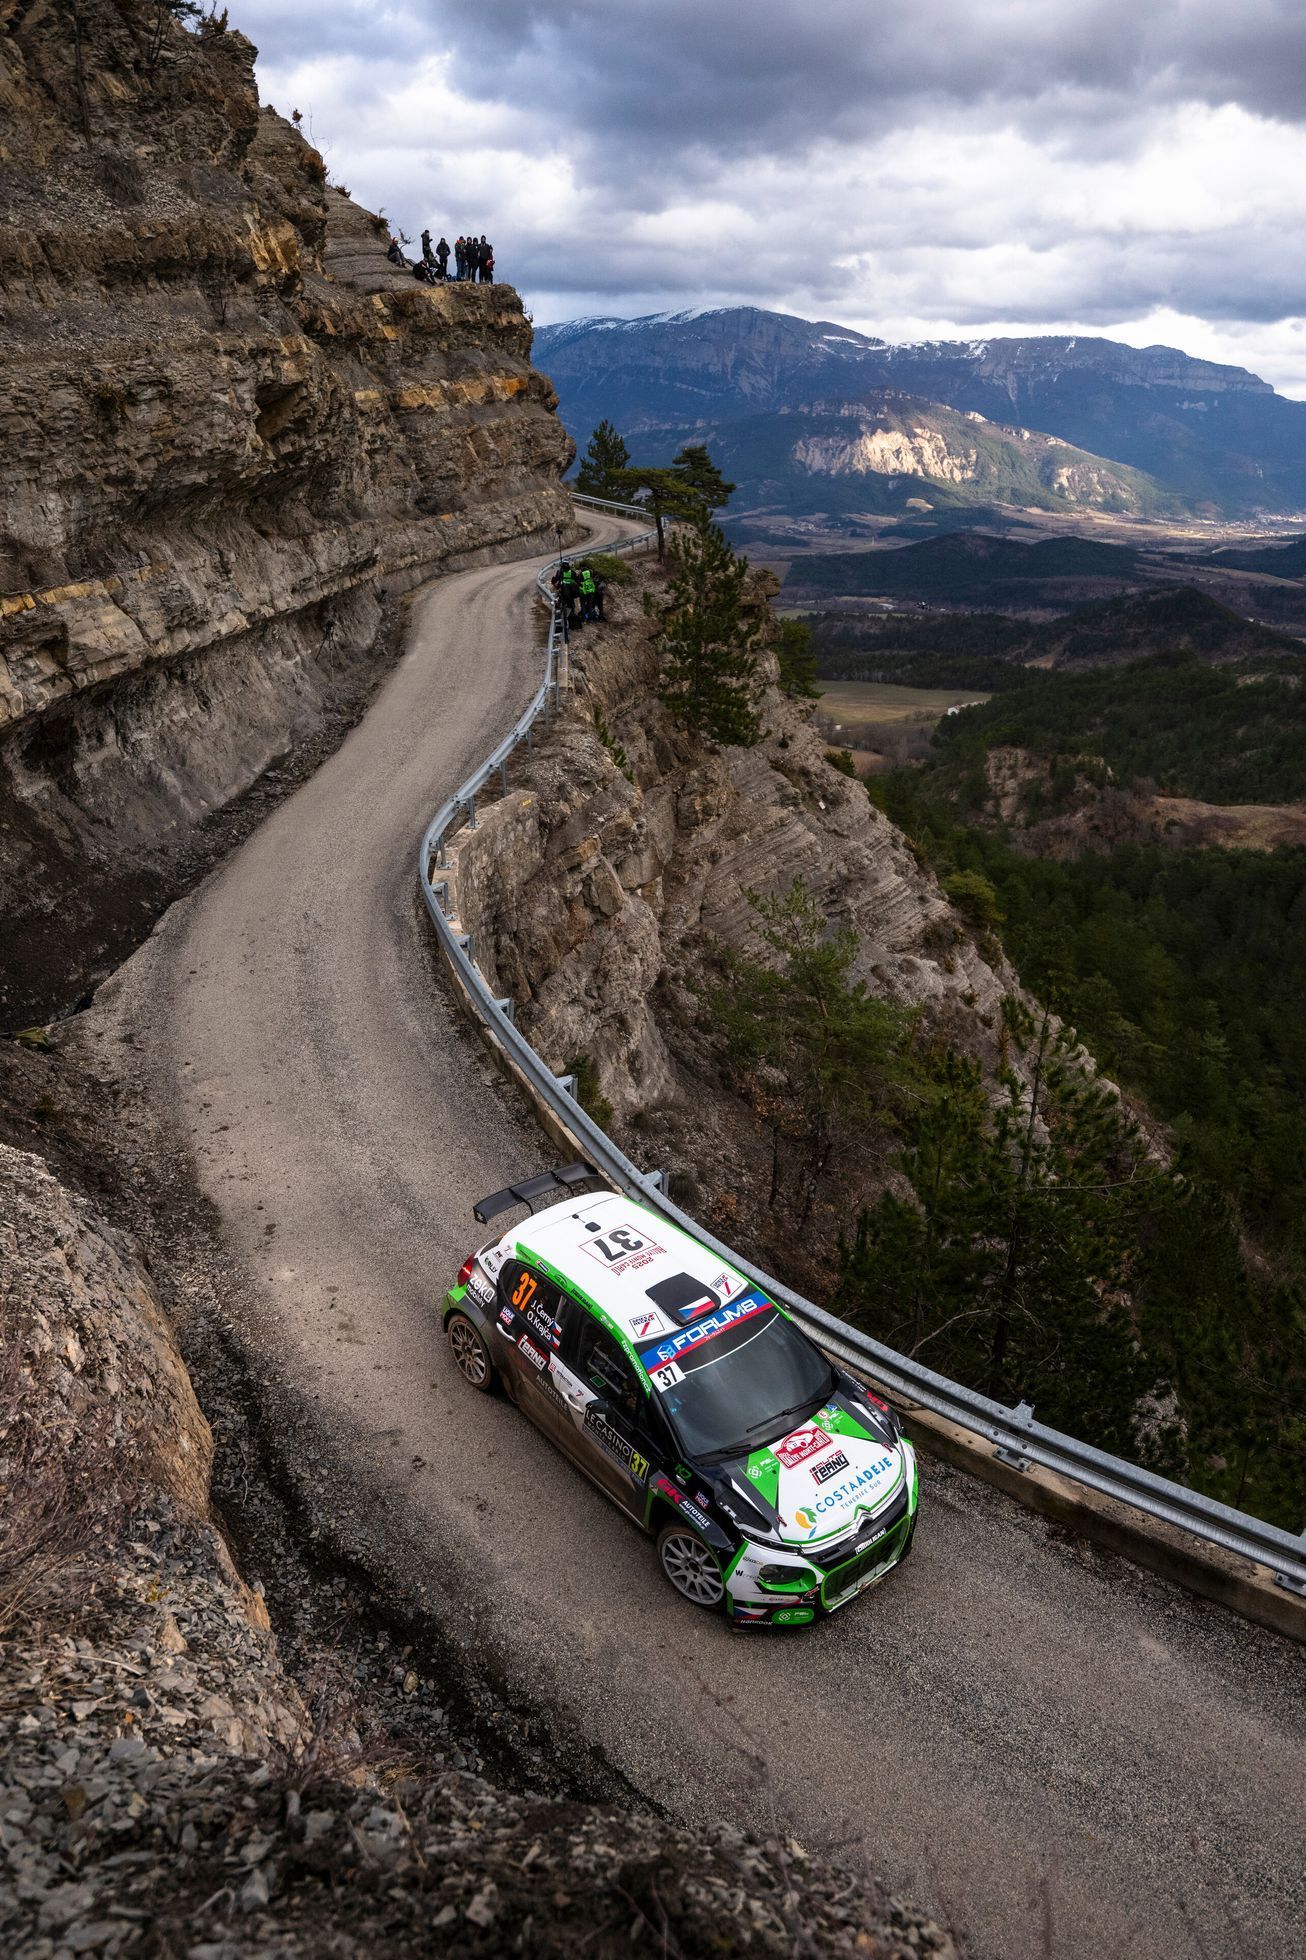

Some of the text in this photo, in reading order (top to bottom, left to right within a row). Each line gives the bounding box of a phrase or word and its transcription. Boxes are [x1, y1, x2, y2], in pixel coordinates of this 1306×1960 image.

[594, 1230, 643, 1262] 37
[611, 1261, 630, 1276] CARLO
[632, 1257, 654, 1269] 2025
[512, 1272, 538, 1311] 37
[527, 1311, 534, 1323] O.
[532, 1318, 552, 1341] Krajča
[531, 1301, 554, 1328] J. Černý
[673, 1298, 758, 1351] FORUM8
[657, 1366, 679, 1388] 37
[586, 1409, 596, 1423] LE
[595, 1419, 630, 1457] CASINO
[630, 1453, 647, 1478] 37
[782, 1450, 801, 1466] RALLYE
[816, 1450, 843, 1470] AUTO
[841, 1489, 868, 1510] TENERIFE
[679, 1500, 711, 1527] AUTOTEILE
